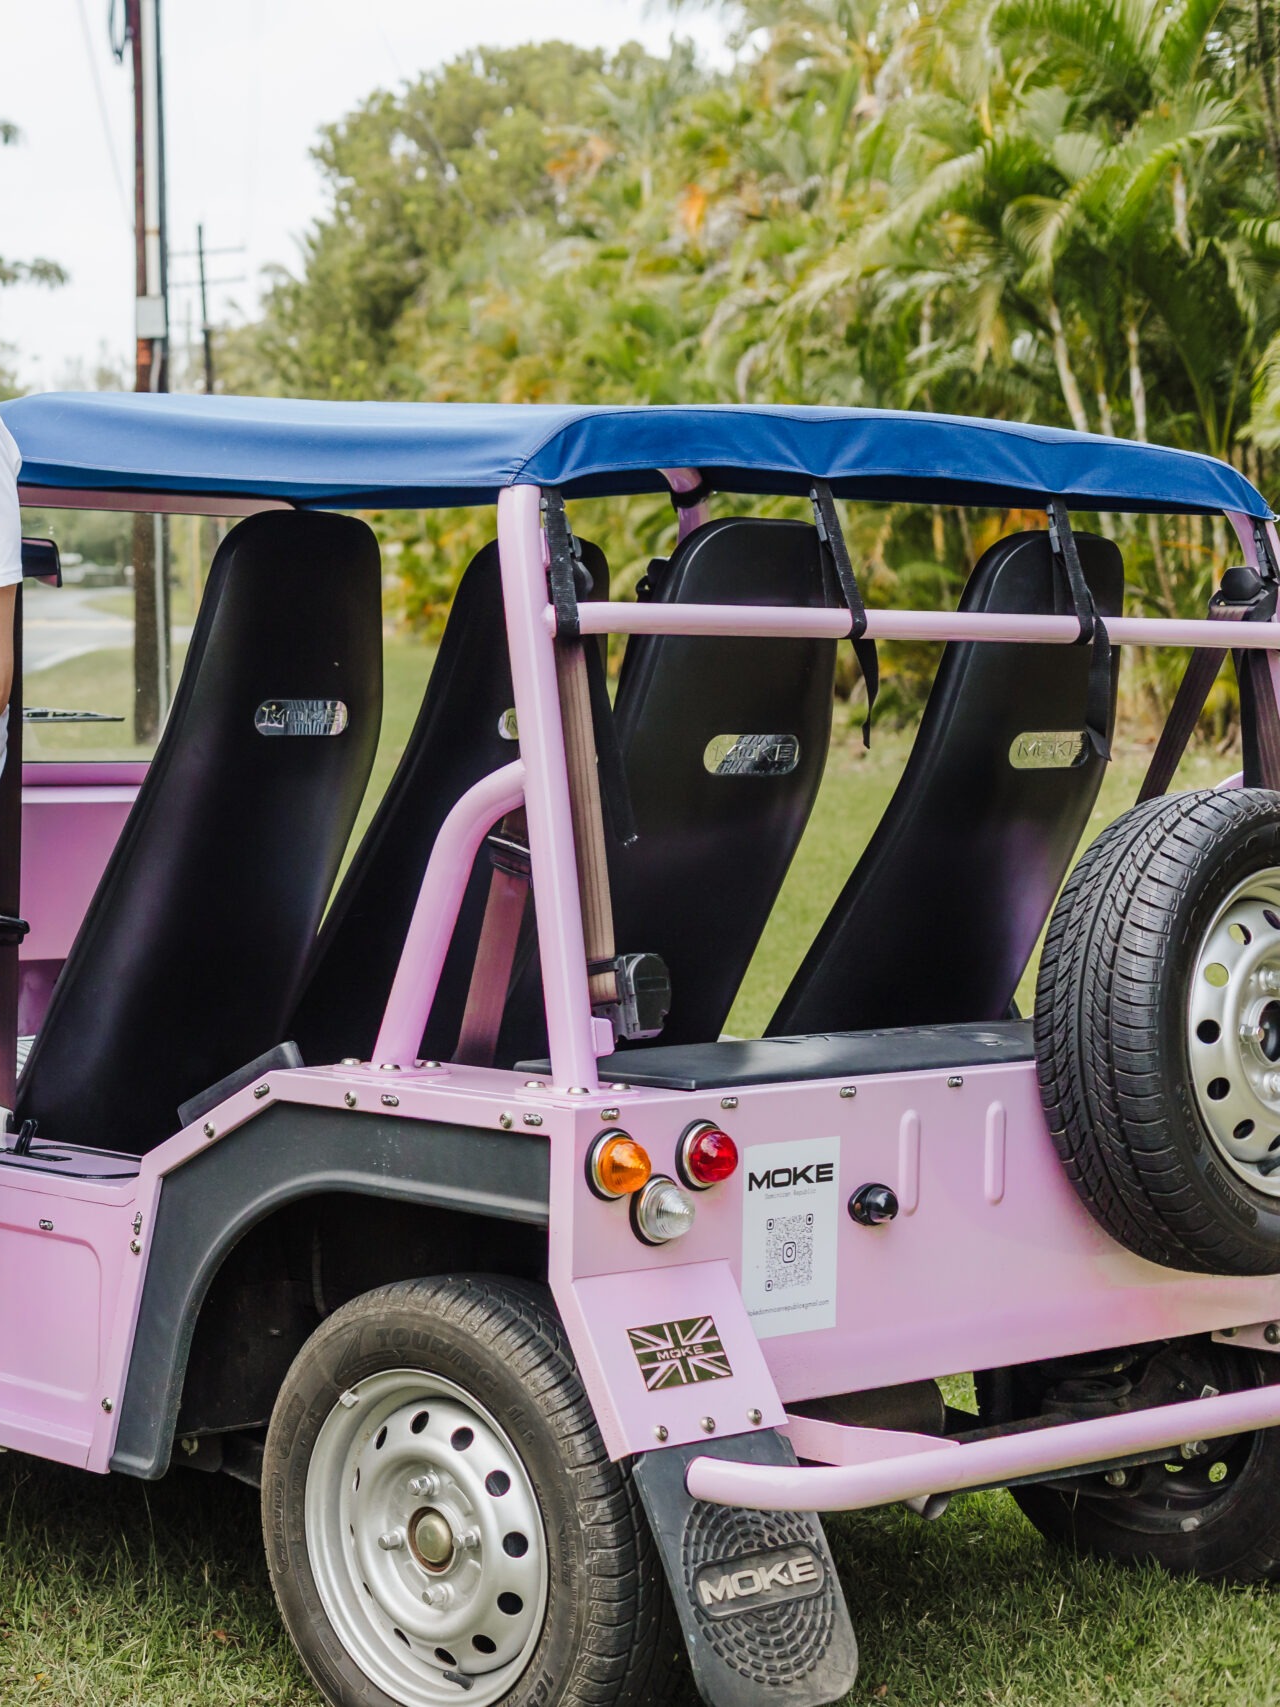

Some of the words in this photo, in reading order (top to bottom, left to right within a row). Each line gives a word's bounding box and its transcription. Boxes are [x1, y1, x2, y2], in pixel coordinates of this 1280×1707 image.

[713, 743, 794, 762] MOKE
[748, 1162, 834, 1191] MOKE
[656, 1345, 705, 1361] MOKE
[698, 1555, 818, 1605] MOKE
